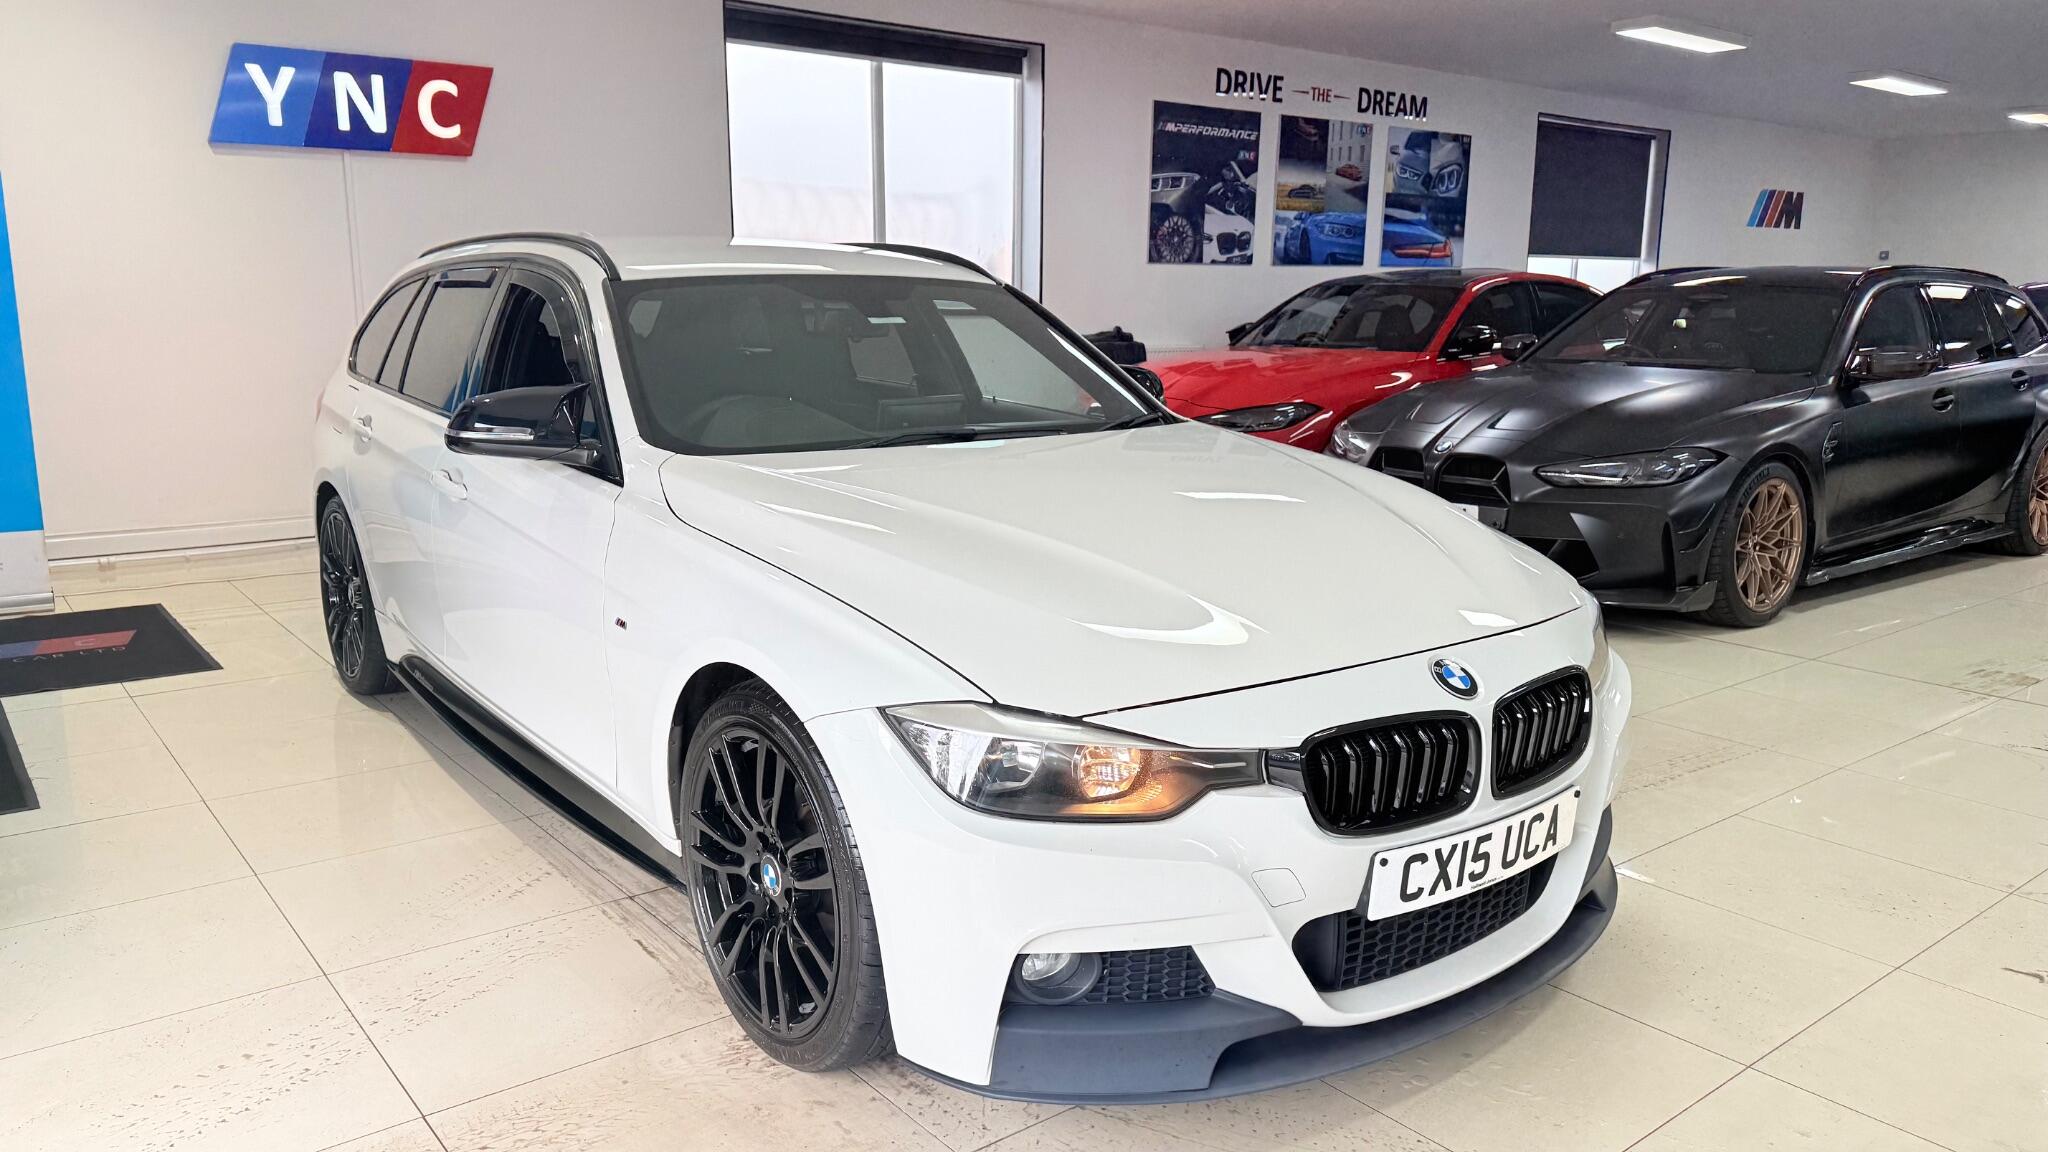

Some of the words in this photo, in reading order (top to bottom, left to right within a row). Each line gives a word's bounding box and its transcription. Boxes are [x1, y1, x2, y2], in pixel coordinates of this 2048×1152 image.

[244, 62, 462, 139] YNC
[1215, 67, 1284, 103] DRIVE
[1311, 86, 1332, 103] THE
[1357, 87, 1428, 119] DREAM
[1400, 832, 1493, 903] CX15
[1501, 803, 1559, 870] UCA
